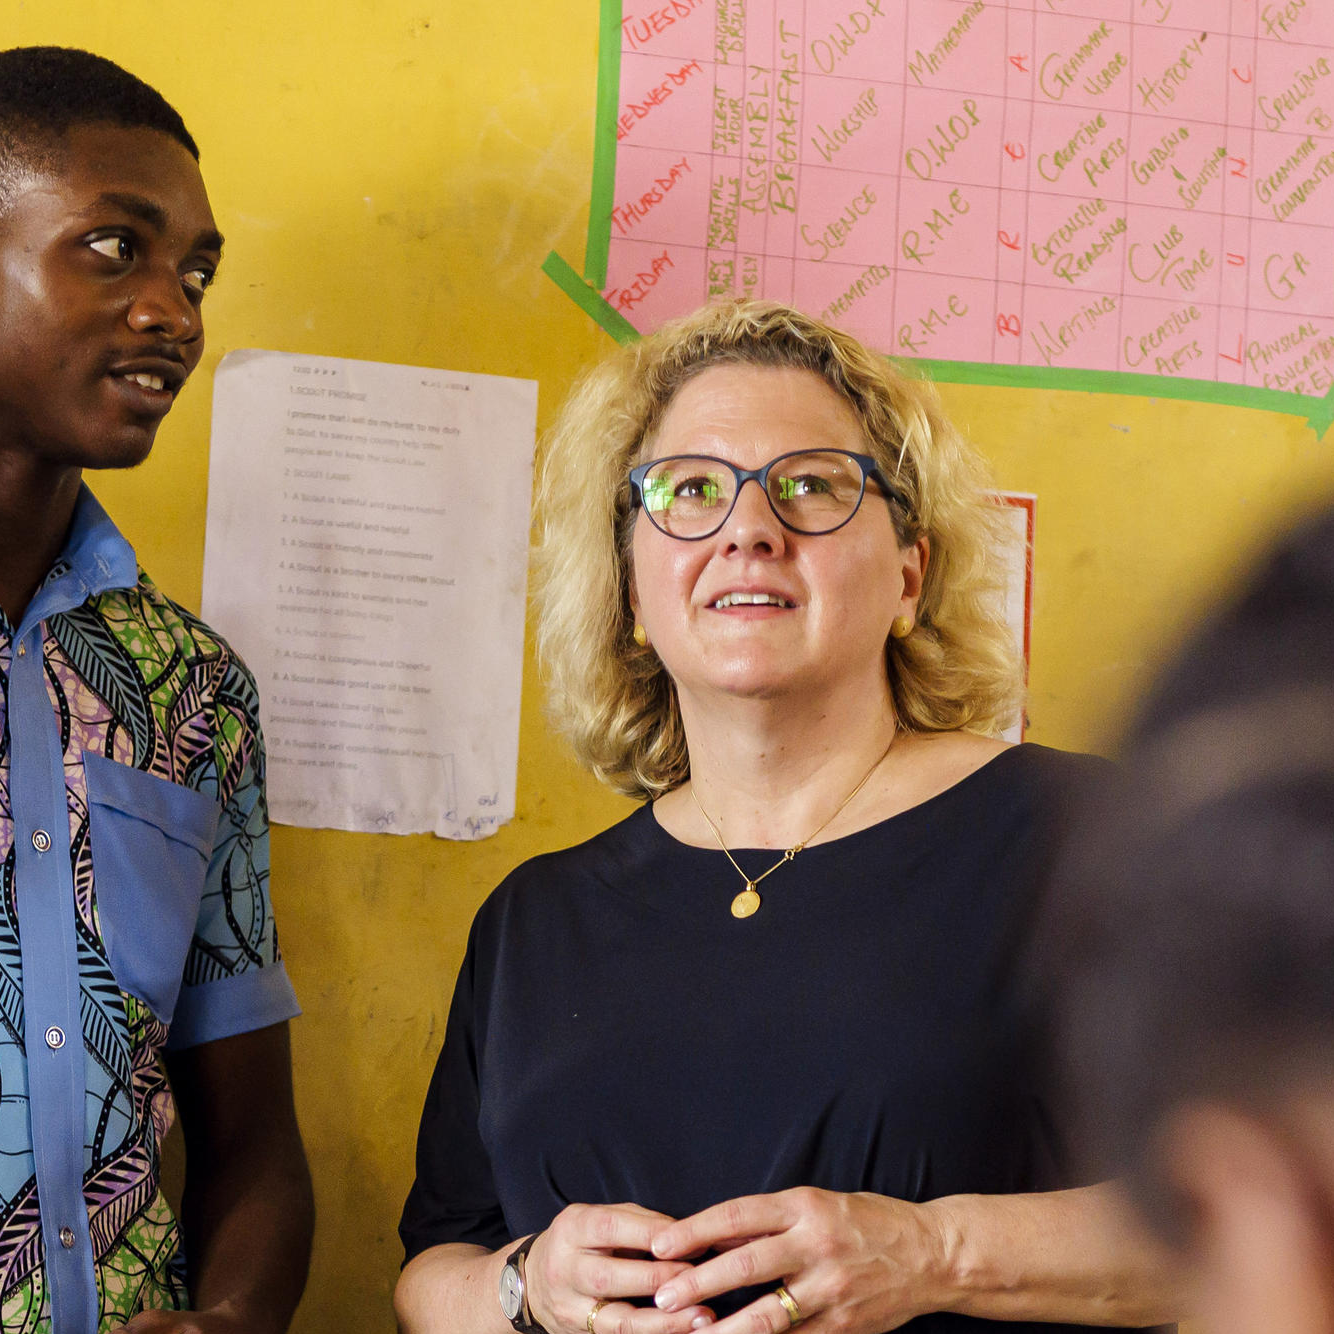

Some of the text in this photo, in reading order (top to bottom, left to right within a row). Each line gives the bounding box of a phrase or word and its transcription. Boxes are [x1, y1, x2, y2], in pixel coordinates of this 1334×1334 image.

[768, 19, 799, 214] BREAKFAST
[811, 88, 878, 162] WORSHIP
[1258, 57, 1331, 132] SPELLING
[741, 65, 771, 215] ASSEMBLY
[1083, 137, 1127, 187] ARTS
[611, 157, 692, 235] THURSDAY
[801, 184, 877, 263] SCIENCE
[1031, 198, 1107, 266] EXTENSIVE
[1030, 296, 1116, 366] WRITING
